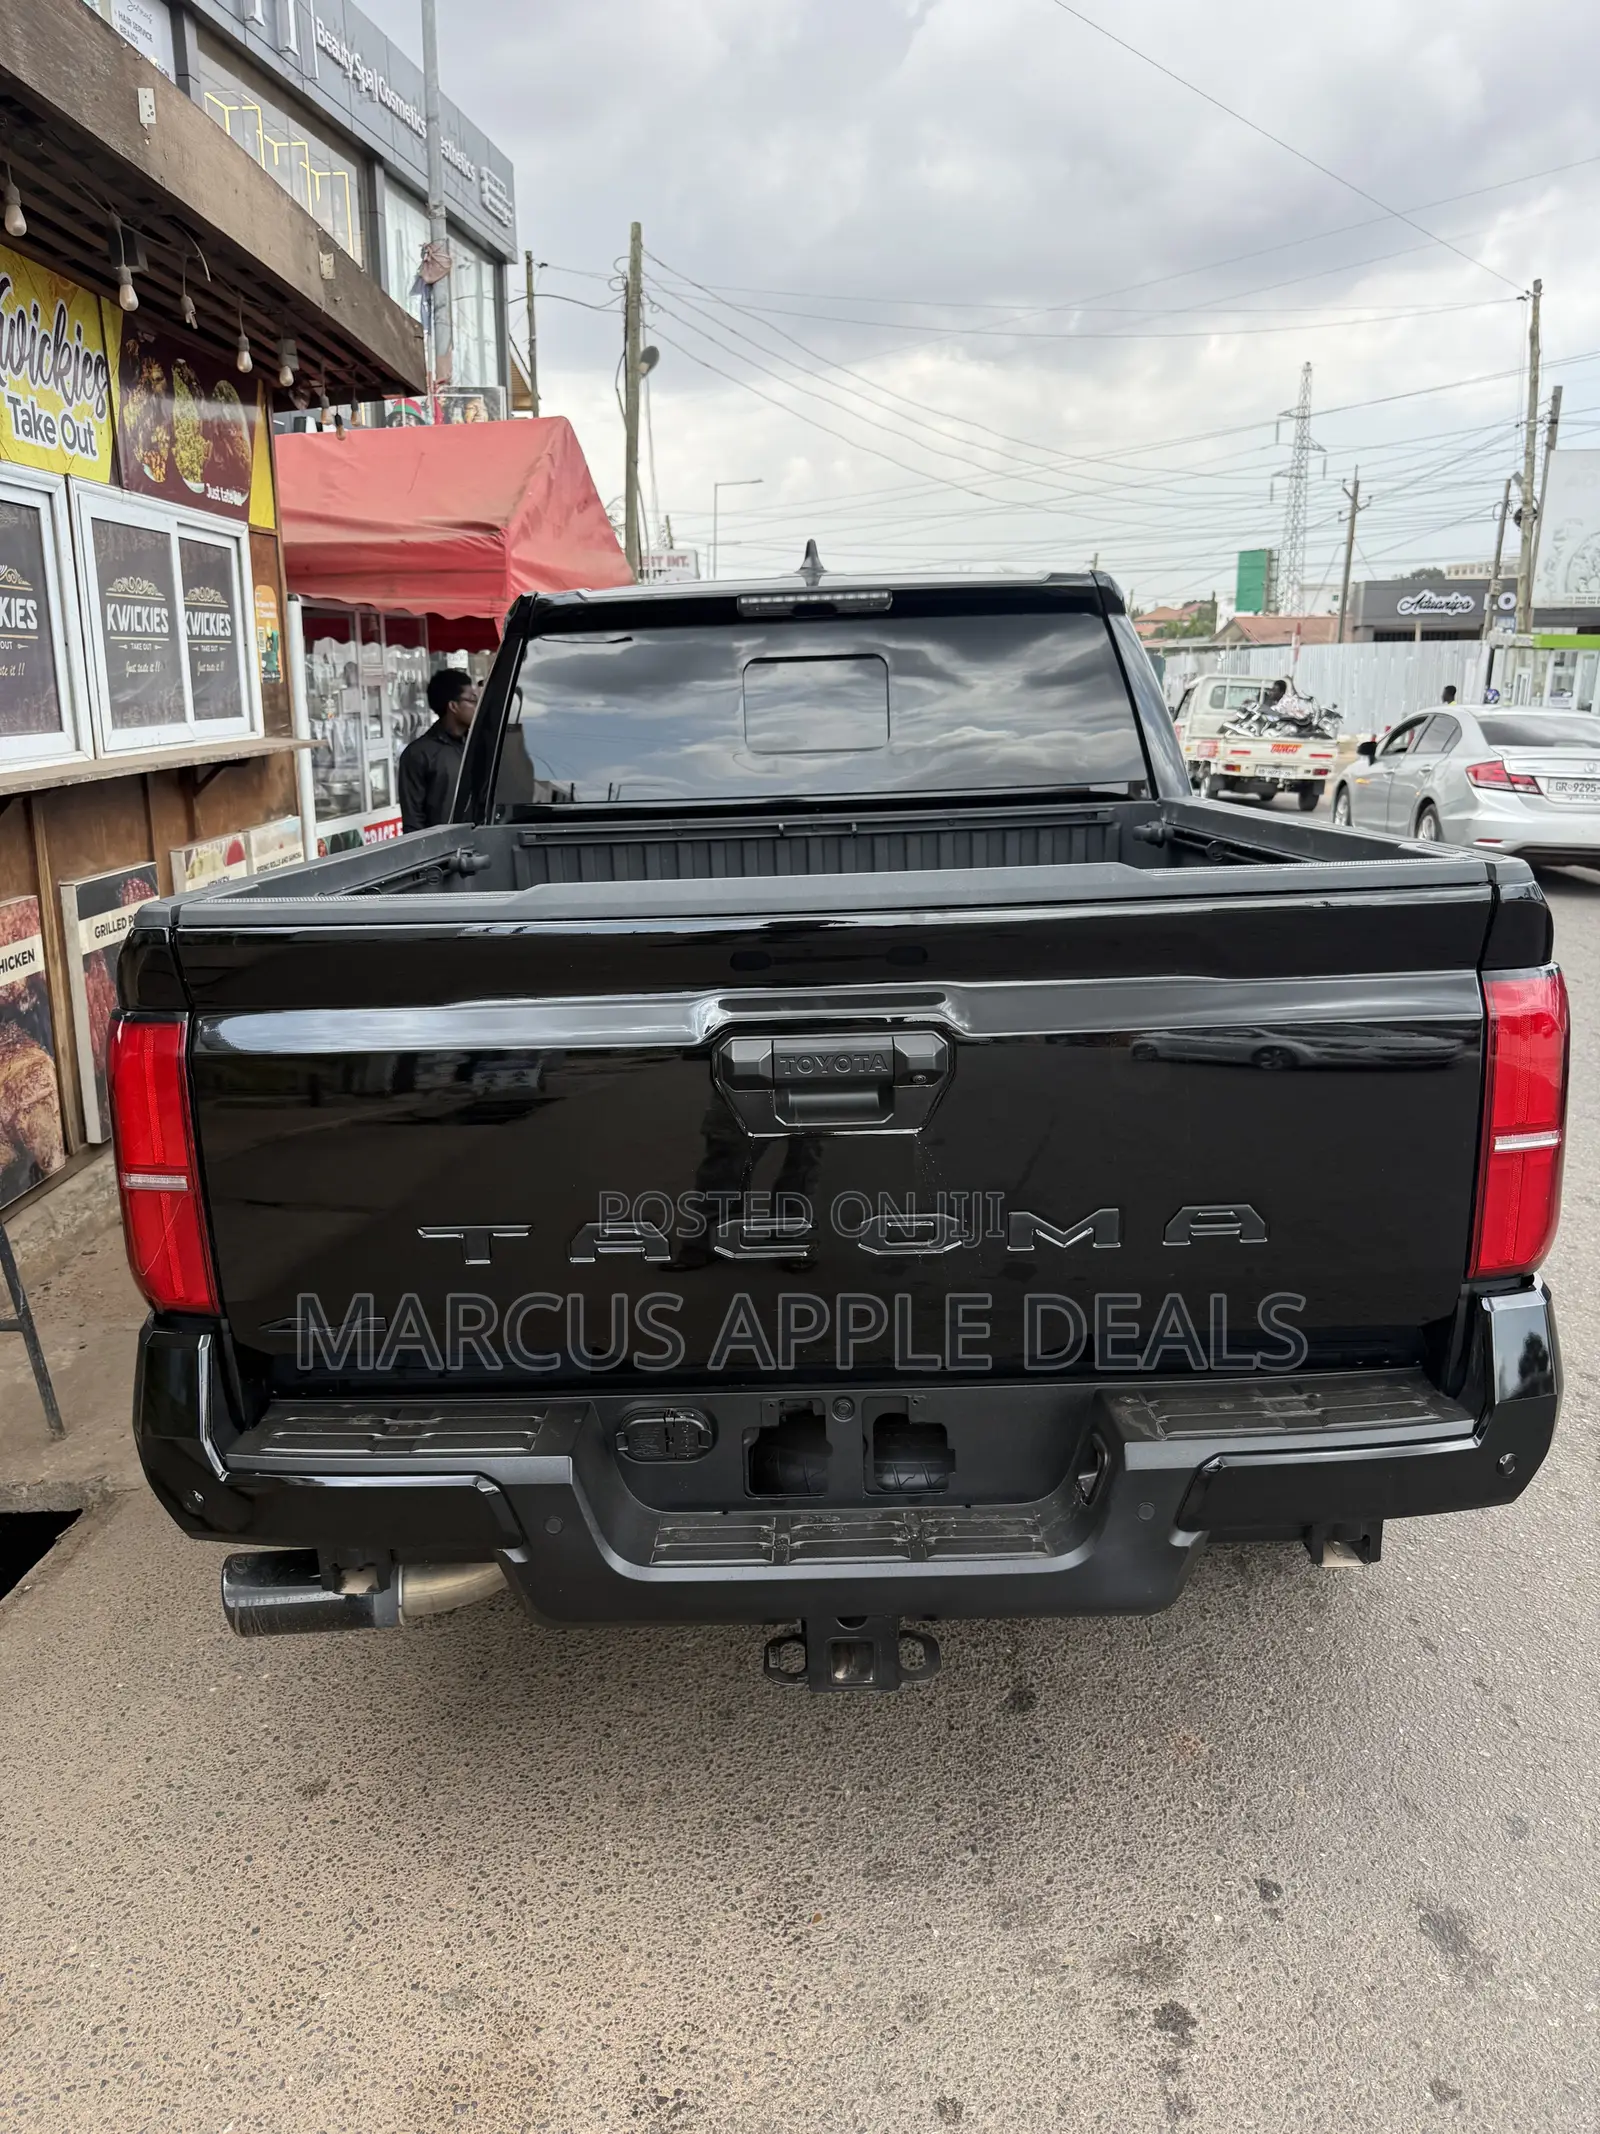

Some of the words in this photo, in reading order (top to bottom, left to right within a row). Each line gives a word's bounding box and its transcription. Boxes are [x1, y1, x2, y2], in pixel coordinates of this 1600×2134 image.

[316, 15, 354, 79] Beauty
[379, 75, 427, 139] Cosmetics
[7, 394, 57, 445] Take
[60, 412, 97, 458] Out
[106, 603, 170, 634] KWICKIES
[1555, 781, 1568, 792] GR
[94, 920, 127, 939] GRILLED
[778, 1053, 889, 1076] TOYOTA
